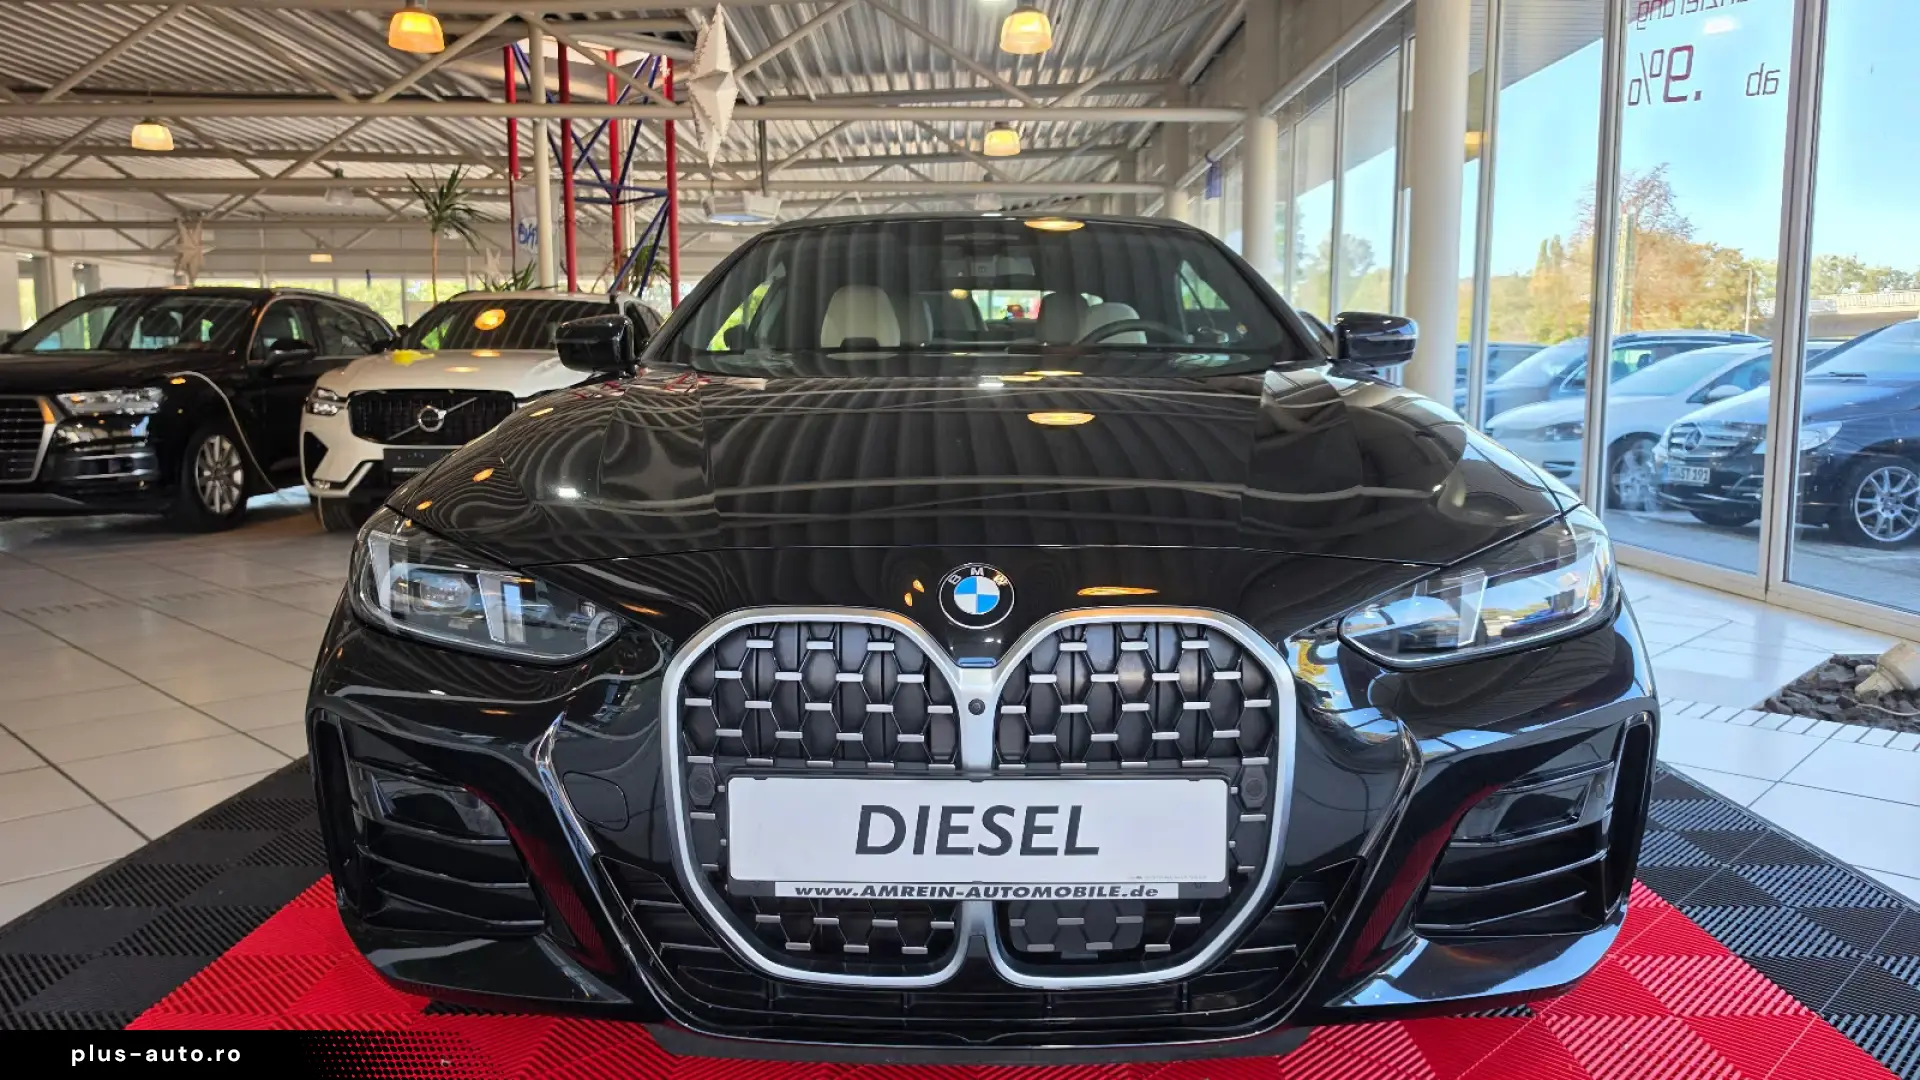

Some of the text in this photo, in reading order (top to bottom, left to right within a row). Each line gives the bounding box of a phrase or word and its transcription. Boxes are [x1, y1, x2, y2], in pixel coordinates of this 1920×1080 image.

[948, 567, 1009, 586] BMW
[855, 804, 1100, 857] DIESEL
[795, 885, 1159, 898] www.AMREIN-AUTOMOBILE.de
